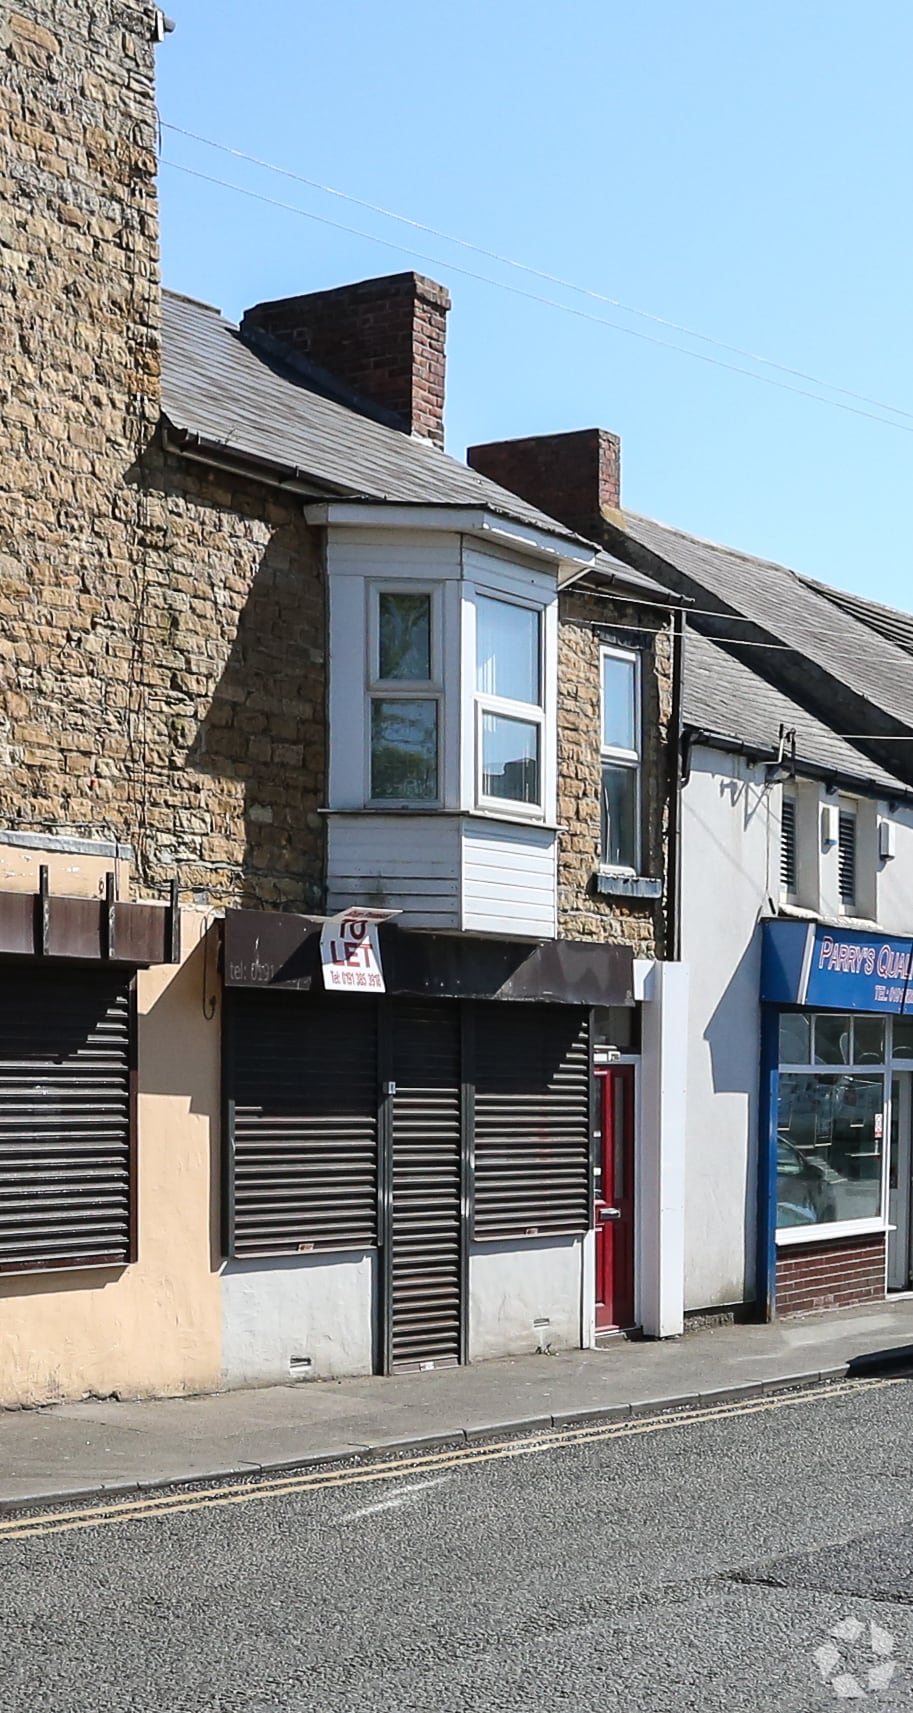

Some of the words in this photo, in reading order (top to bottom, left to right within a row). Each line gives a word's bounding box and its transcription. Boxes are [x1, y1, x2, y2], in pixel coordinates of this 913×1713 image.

[340, 918, 369, 940] TO
[330, 940, 374, 968] LET
[818, 936, 875, 975] PARRY'S
